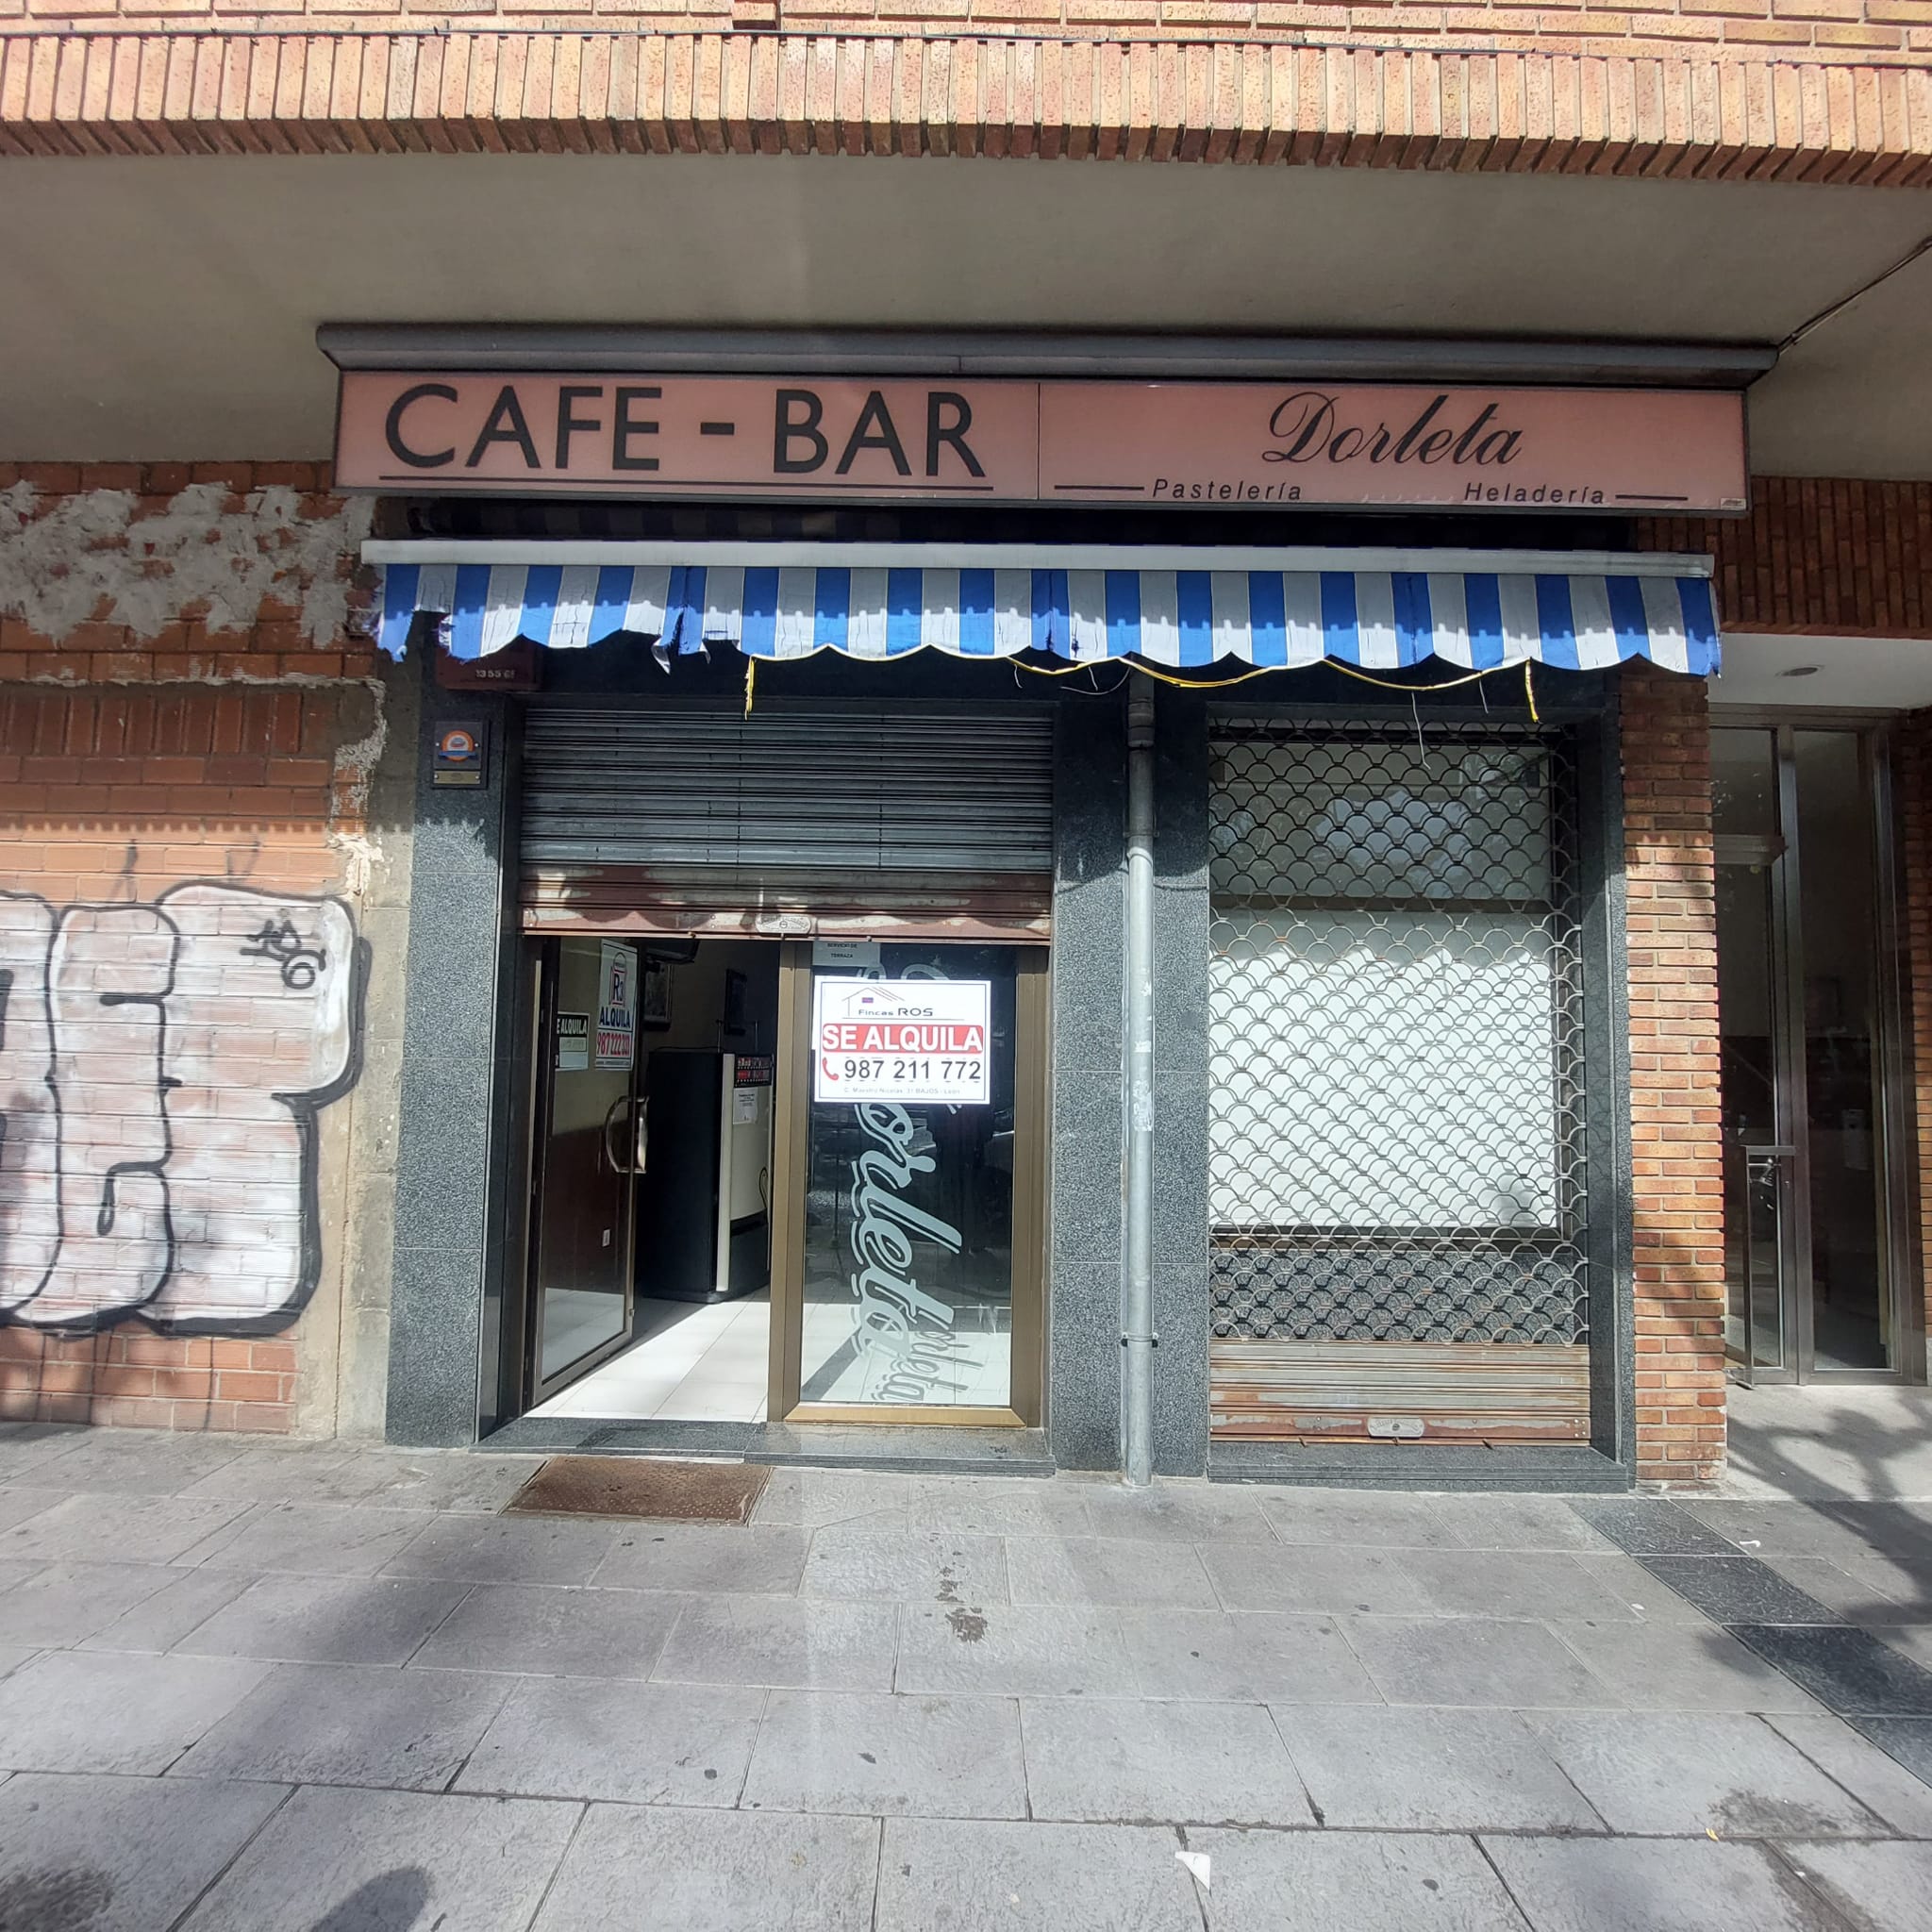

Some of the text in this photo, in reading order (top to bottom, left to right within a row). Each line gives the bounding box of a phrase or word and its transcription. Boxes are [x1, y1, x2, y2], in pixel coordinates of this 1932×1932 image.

[385, 382, 662, 471] CAFE
[773, 389, 987, 478] BAR
[1261, 390, 1524, 467] Dorleta
[1152, 477, 1302, 502] Pastelería
[1463, 481, 1606, 507] Heladería
[599, 1007, 631, 1028] ALQUILA
[897, 1008, 934, 1017] ROS
[560, 1019, 588, 1034] ALQUILA
[823, 1024, 983, 1052] SE ALQUILA
[844, 1059, 981, 1080] 987 211 772
